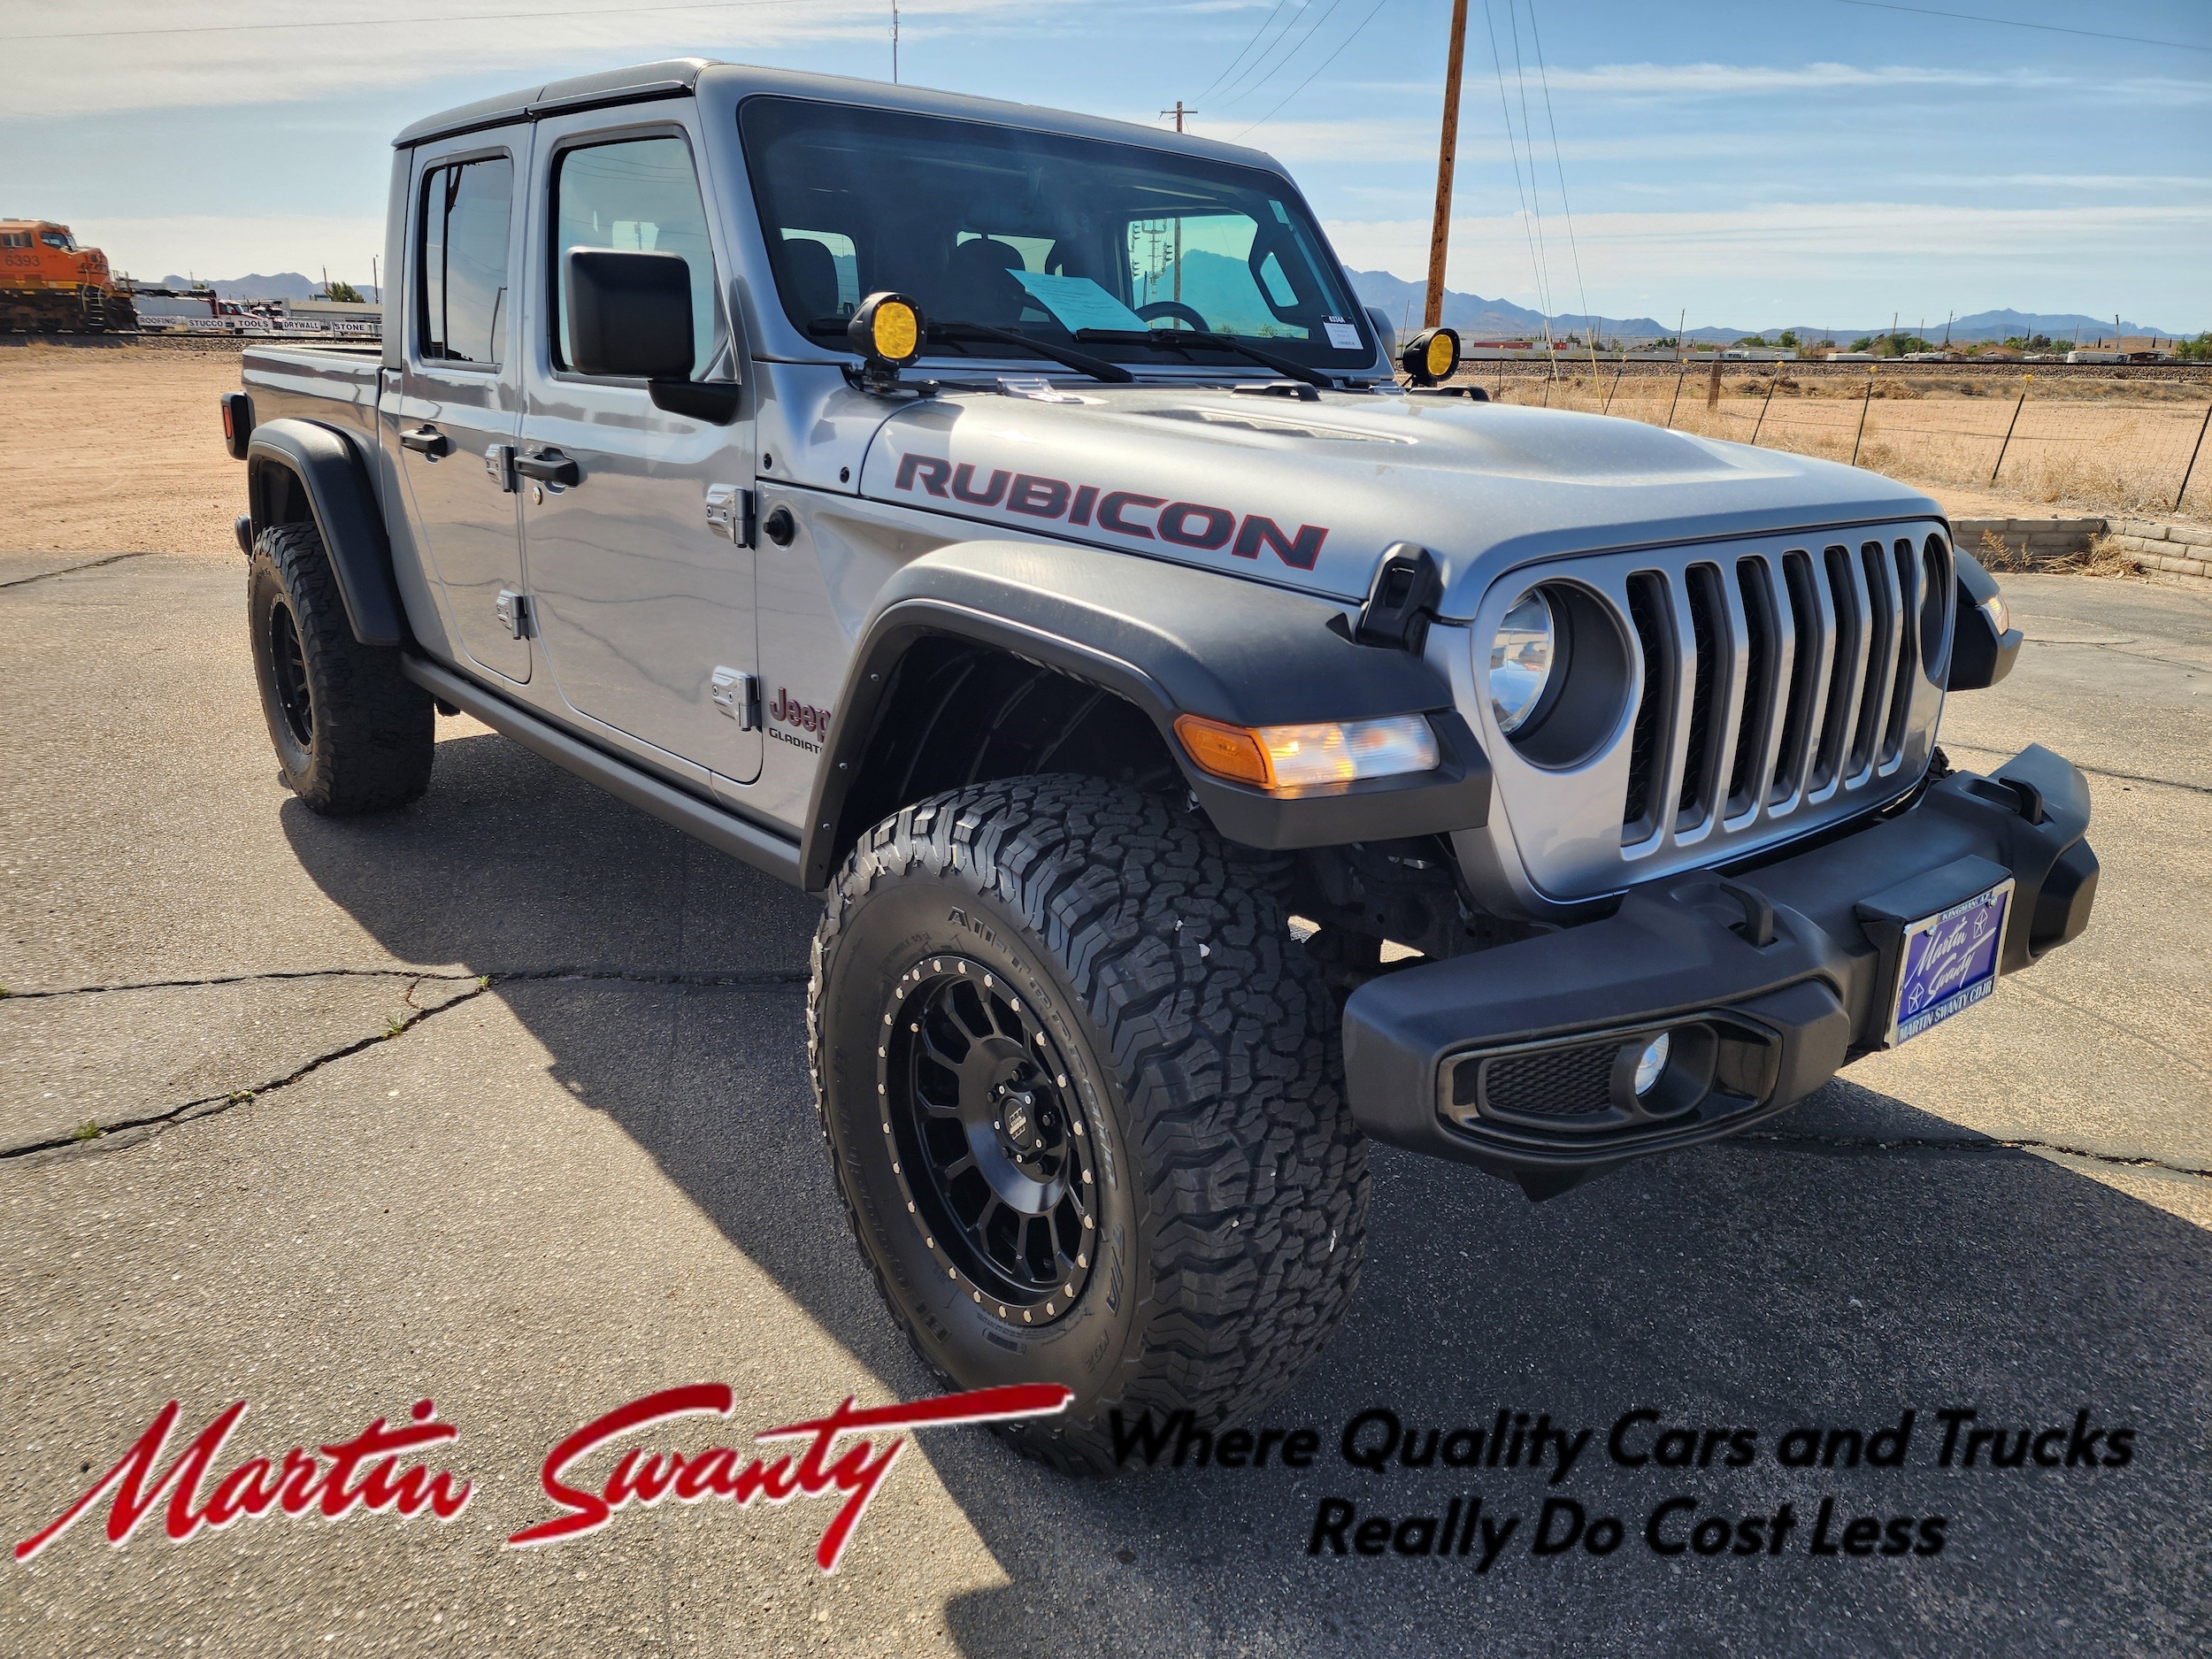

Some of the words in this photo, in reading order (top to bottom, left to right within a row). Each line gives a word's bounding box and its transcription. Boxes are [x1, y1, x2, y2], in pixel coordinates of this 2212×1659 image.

[4, 255, 41, 266] 6393
[895, 452, 1330, 572] RUBICON
[769, 686, 831, 743] Jeep
[769, 727, 823, 754] GLADIAT
[1904, 916, 1968, 988] Martin
[1922, 926, 1997, 1009] Swanty
[1898, 1011, 1935, 1042] MARTIN
[1933, 993, 1970, 1023] SWANTY
[1969, 979, 1993, 1002] CDJR
